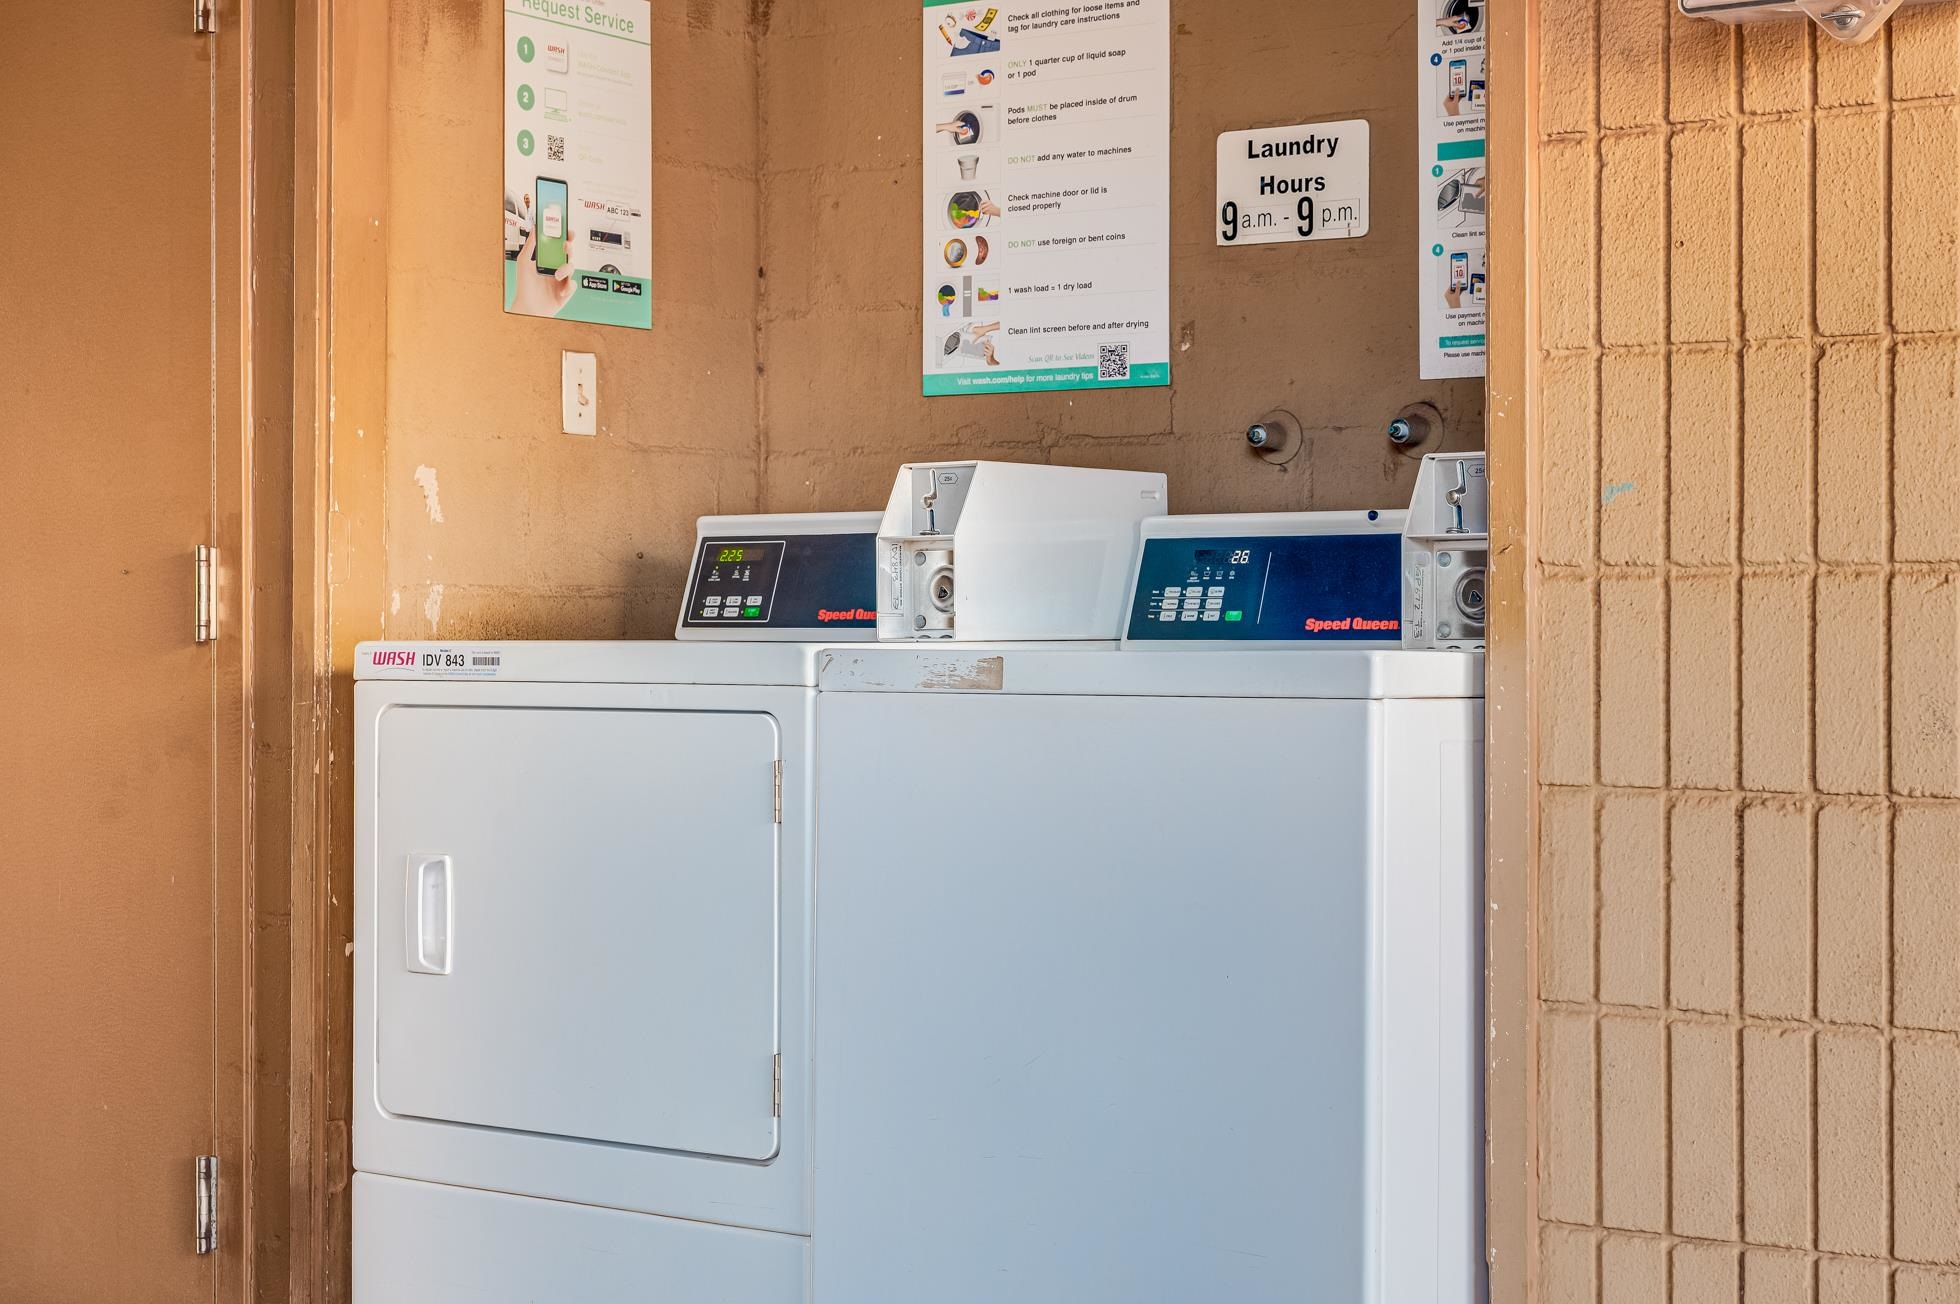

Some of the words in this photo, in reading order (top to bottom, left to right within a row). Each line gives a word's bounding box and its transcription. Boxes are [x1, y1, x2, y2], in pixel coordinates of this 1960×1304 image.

[1008, 13, 1029, 22] Check
[1041, 9, 1069, 19] clothing
[1071, 8, 1082, 16] for
[1084, 4, 1102, 13] loose
[1104, 2, 1124, 11] items
[1127, 0, 1140, 8] and
[584, 6, 634, 33] Service
[1008, 25, 1018, 33] tag
[1020, 23, 1030, 31] for
[1032, 19, 1058, 30] laundry
[1078, 12, 1120, 24] instructions
[524, 44, 528, 54] 1
[1008, 59, 1026, 69] ONLY
[1035, 55, 1060, 67] quarter
[1062, 54, 1075, 64] cup
[1078, 52, 1084, 60] of
[1087, 49, 1106, 60] liquid
[1108, 49, 1126, 58] soap
[1023, 69, 1036, 78] pod
[522, 92, 528, 103] 2
[1008, 106, 1025, 114] Pods
[1027, 104, 1047, 113] MUST
[1060, 99, 1084, 111] placed
[1086, 98, 1107, 107] inside
[1118, 94, 1137, 103] drum
[1008, 116, 1030, 125] before
[1032, 113, 1056, 123] clothes
[1456, 118, 1479, 126] payment
[522, 137, 528, 149] 3
[1248, 134, 1339, 159] Laundry
[1008, 156, 1018, 164] DO
[1021, 155, 1035, 163] NOT
[1052, 153, 1065, 162] any
[1097, 145, 1132, 155] machines
[1260, 175, 1325, 195] Hours
[1008, 194, 1029, 202] Check
[1031, 190, 1060, 200] machine
[1063, 188, 1079, 197] door
[1008, 203, 1030, 212] closed
[1033, 201, 1061, 211] properly
[1222, 201, 1238, 241] 9
[1242, 211, 1277, 228] a.m.
[1297, 196, 1314, 237] 9
[1322, 206, 1357, 228] p.m.
[1021, 239, 1035, 247] NOT
[1052, 236, 1077, 246] foreign
[1088, 233, 1104, 242] bent
[1106, 232, 1125, 241] coins
[1063, 283, 1074, 292] dry
[1030, 326, 1041, 334] lint
[1068, 323, 1091, 331] before
[1107, 320, 1124, 329] after
[1126, 319, 1149, 329] drying
[957, 376, 971, 385] Visit
[972, 374, 1024, 385] wash.com/help
[1055, 373, 1079, 381] laundry
[1081, 372, 1093, 380] tips
[1231, 550, 1250, 564] 26
[817, 608, 855, 623] Speed
[1305, 617, 1350, 632] Speed
[1352, 617, 1398, 631] Queen
[373, 652, 416, 665] WASH
[422, 654, 441, 666] IDV
[446, 654, 464, 666] 843
